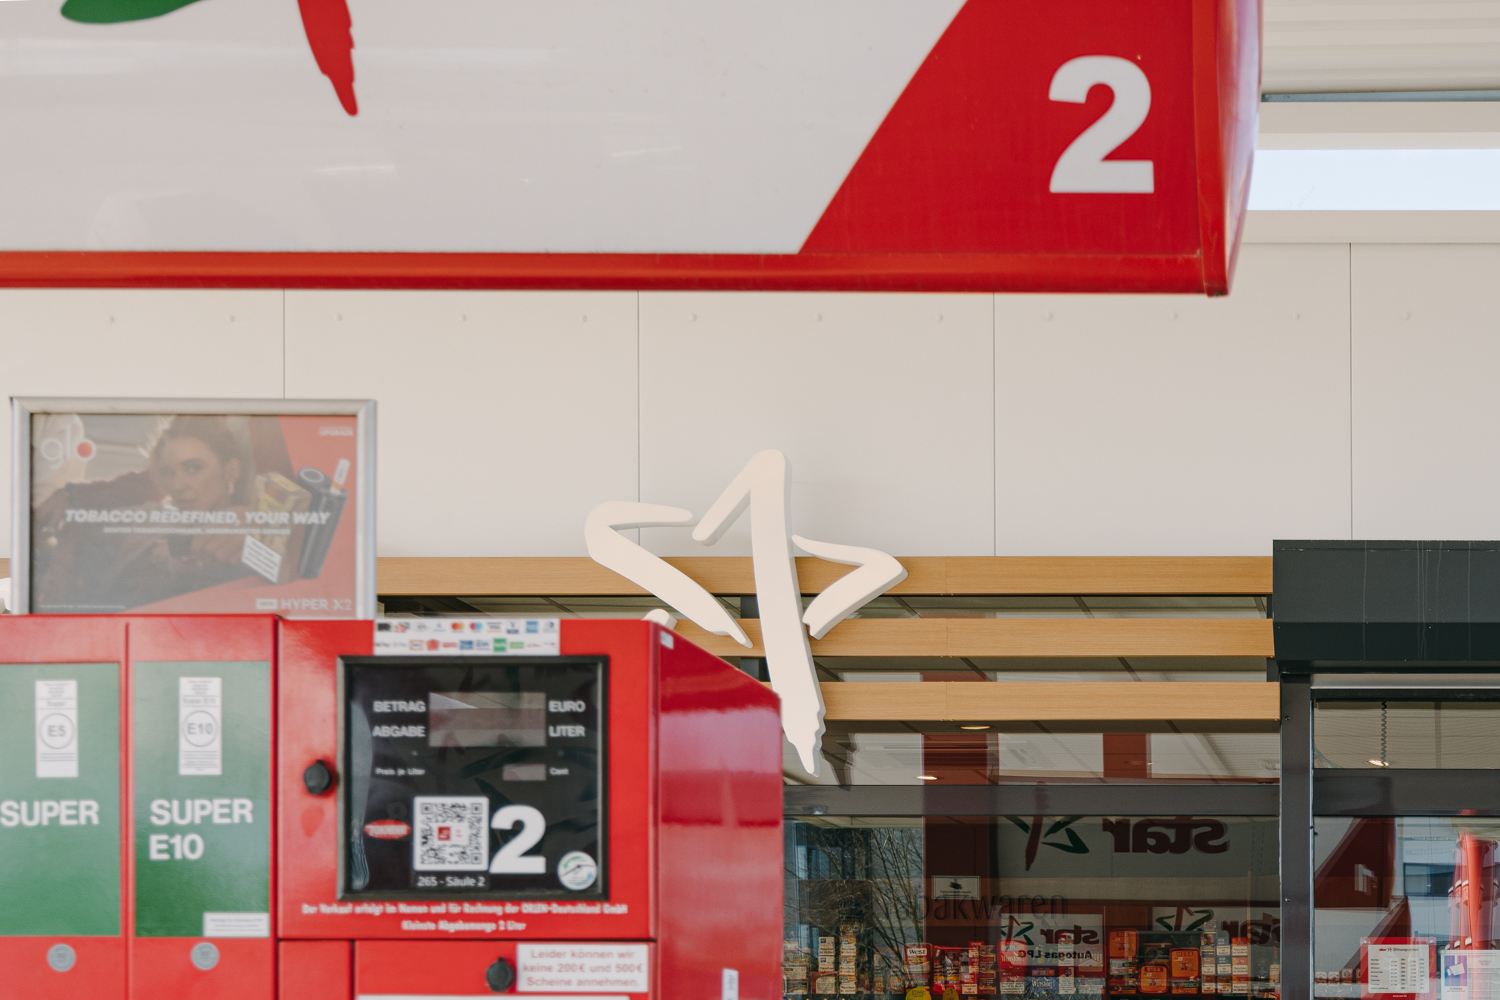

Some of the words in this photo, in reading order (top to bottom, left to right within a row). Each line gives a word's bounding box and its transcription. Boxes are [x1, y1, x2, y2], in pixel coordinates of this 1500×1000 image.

[1048, 54, 1154, 194] 2
[65, 509, 147, 524] TOBACCO
[150, 509, 240, 526] REDEFINED,
[245, 510, 291, 525] YOUR
[291, 511, 331, 525] WAY
[281, 598, 328, 610] HYPER
[373, 701, 426, 713] BETRAG
[549, 701, 586, 713] EURO
[47, 725, 67, 738] E5
[187, 722, 213, 736] E10
[372, 726, 426, 738] ABGABE
[549, 726, 586, 737] LITER
[407, 767, 426, 776] Liter
[0, 800, 100, 826] SUPER
[149, 798, 254, 825] SUPER
[489, 805, 546, 874] 2
[149, 833, 205, 861] E10
[417, 876, 437, 887] 265
[446, 876, 475, 888] Säule
[476, 876, 486, 887] 2
[530, 949, 567, 959] Leider
[571, 949, 614, 959] können
[618, 949, 635, 959] wir
[523, 963, 554, 973] keine
[590, 963, 612, 973] und
[526, 976, 572, 987] Scheine
[576, 977, 641, 987] annehmen.
